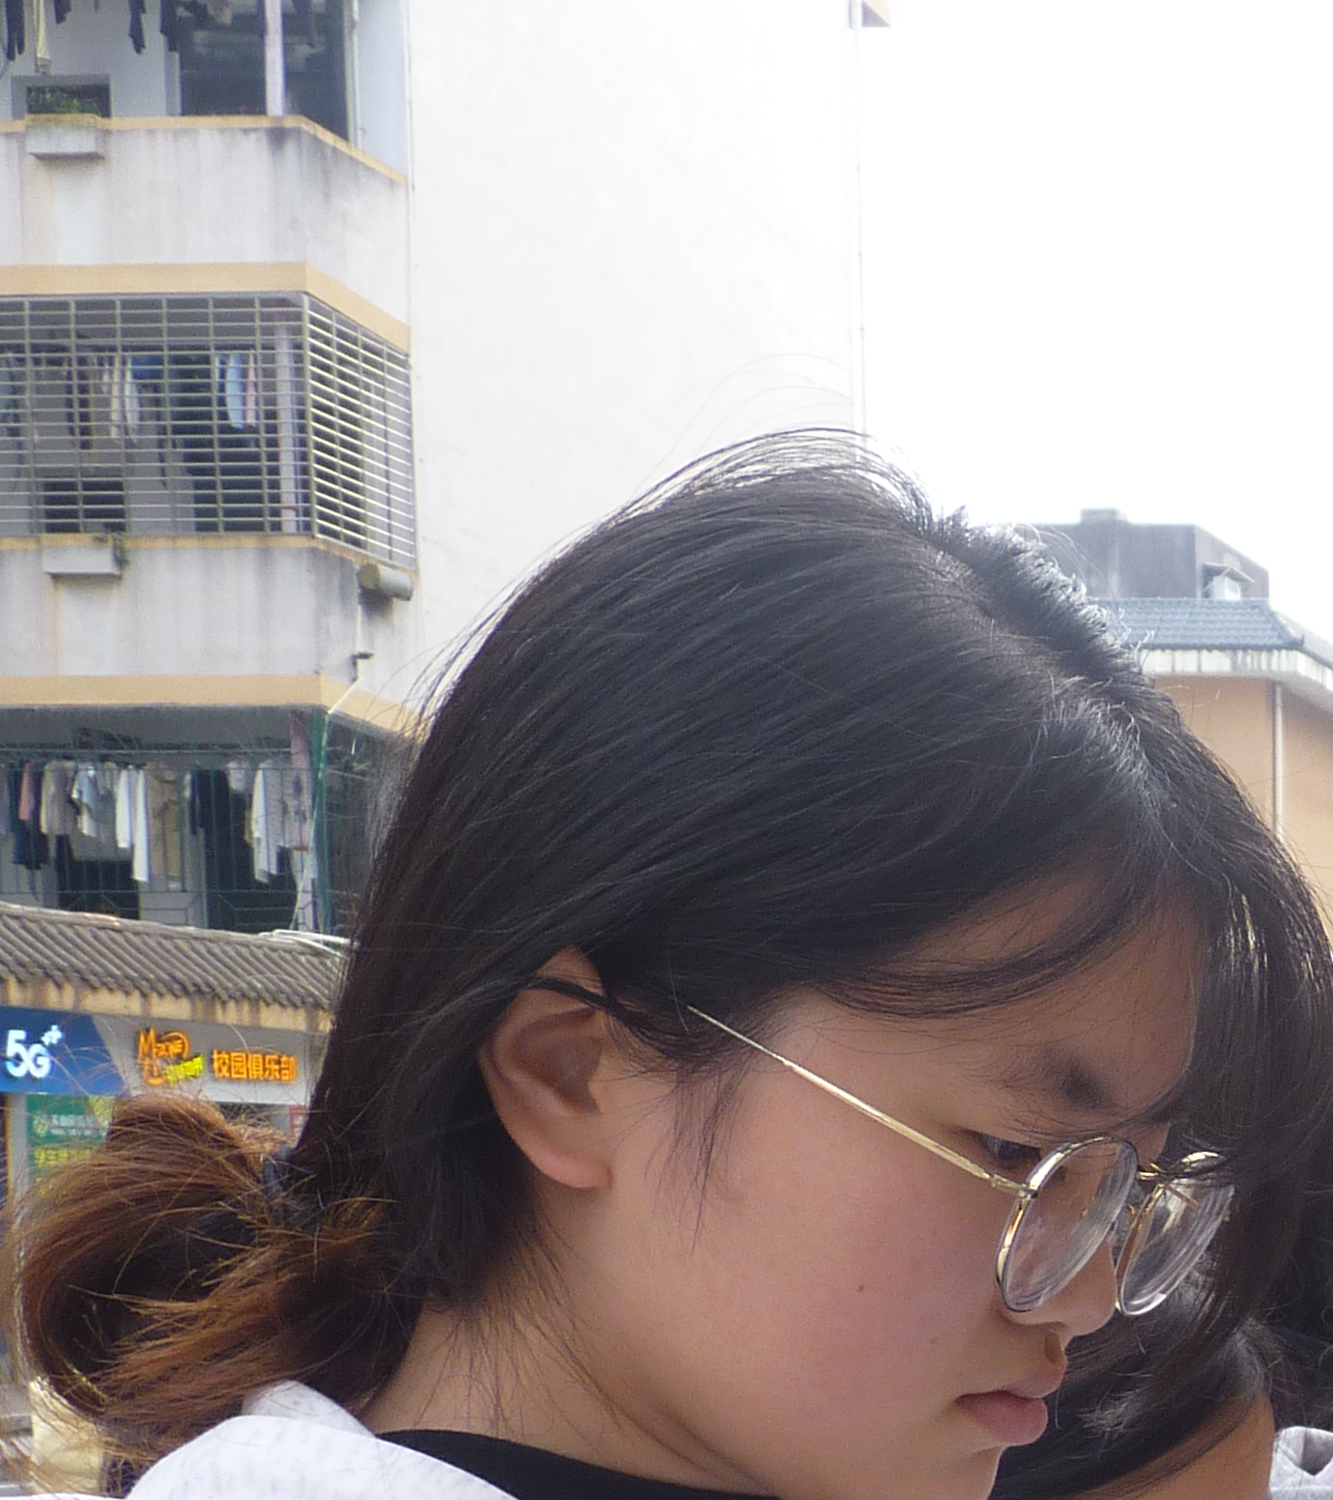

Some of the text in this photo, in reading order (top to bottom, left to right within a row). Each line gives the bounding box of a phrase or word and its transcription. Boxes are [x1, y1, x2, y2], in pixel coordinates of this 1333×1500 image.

[212, 1049, 297, 1083] 校园俱乐部
